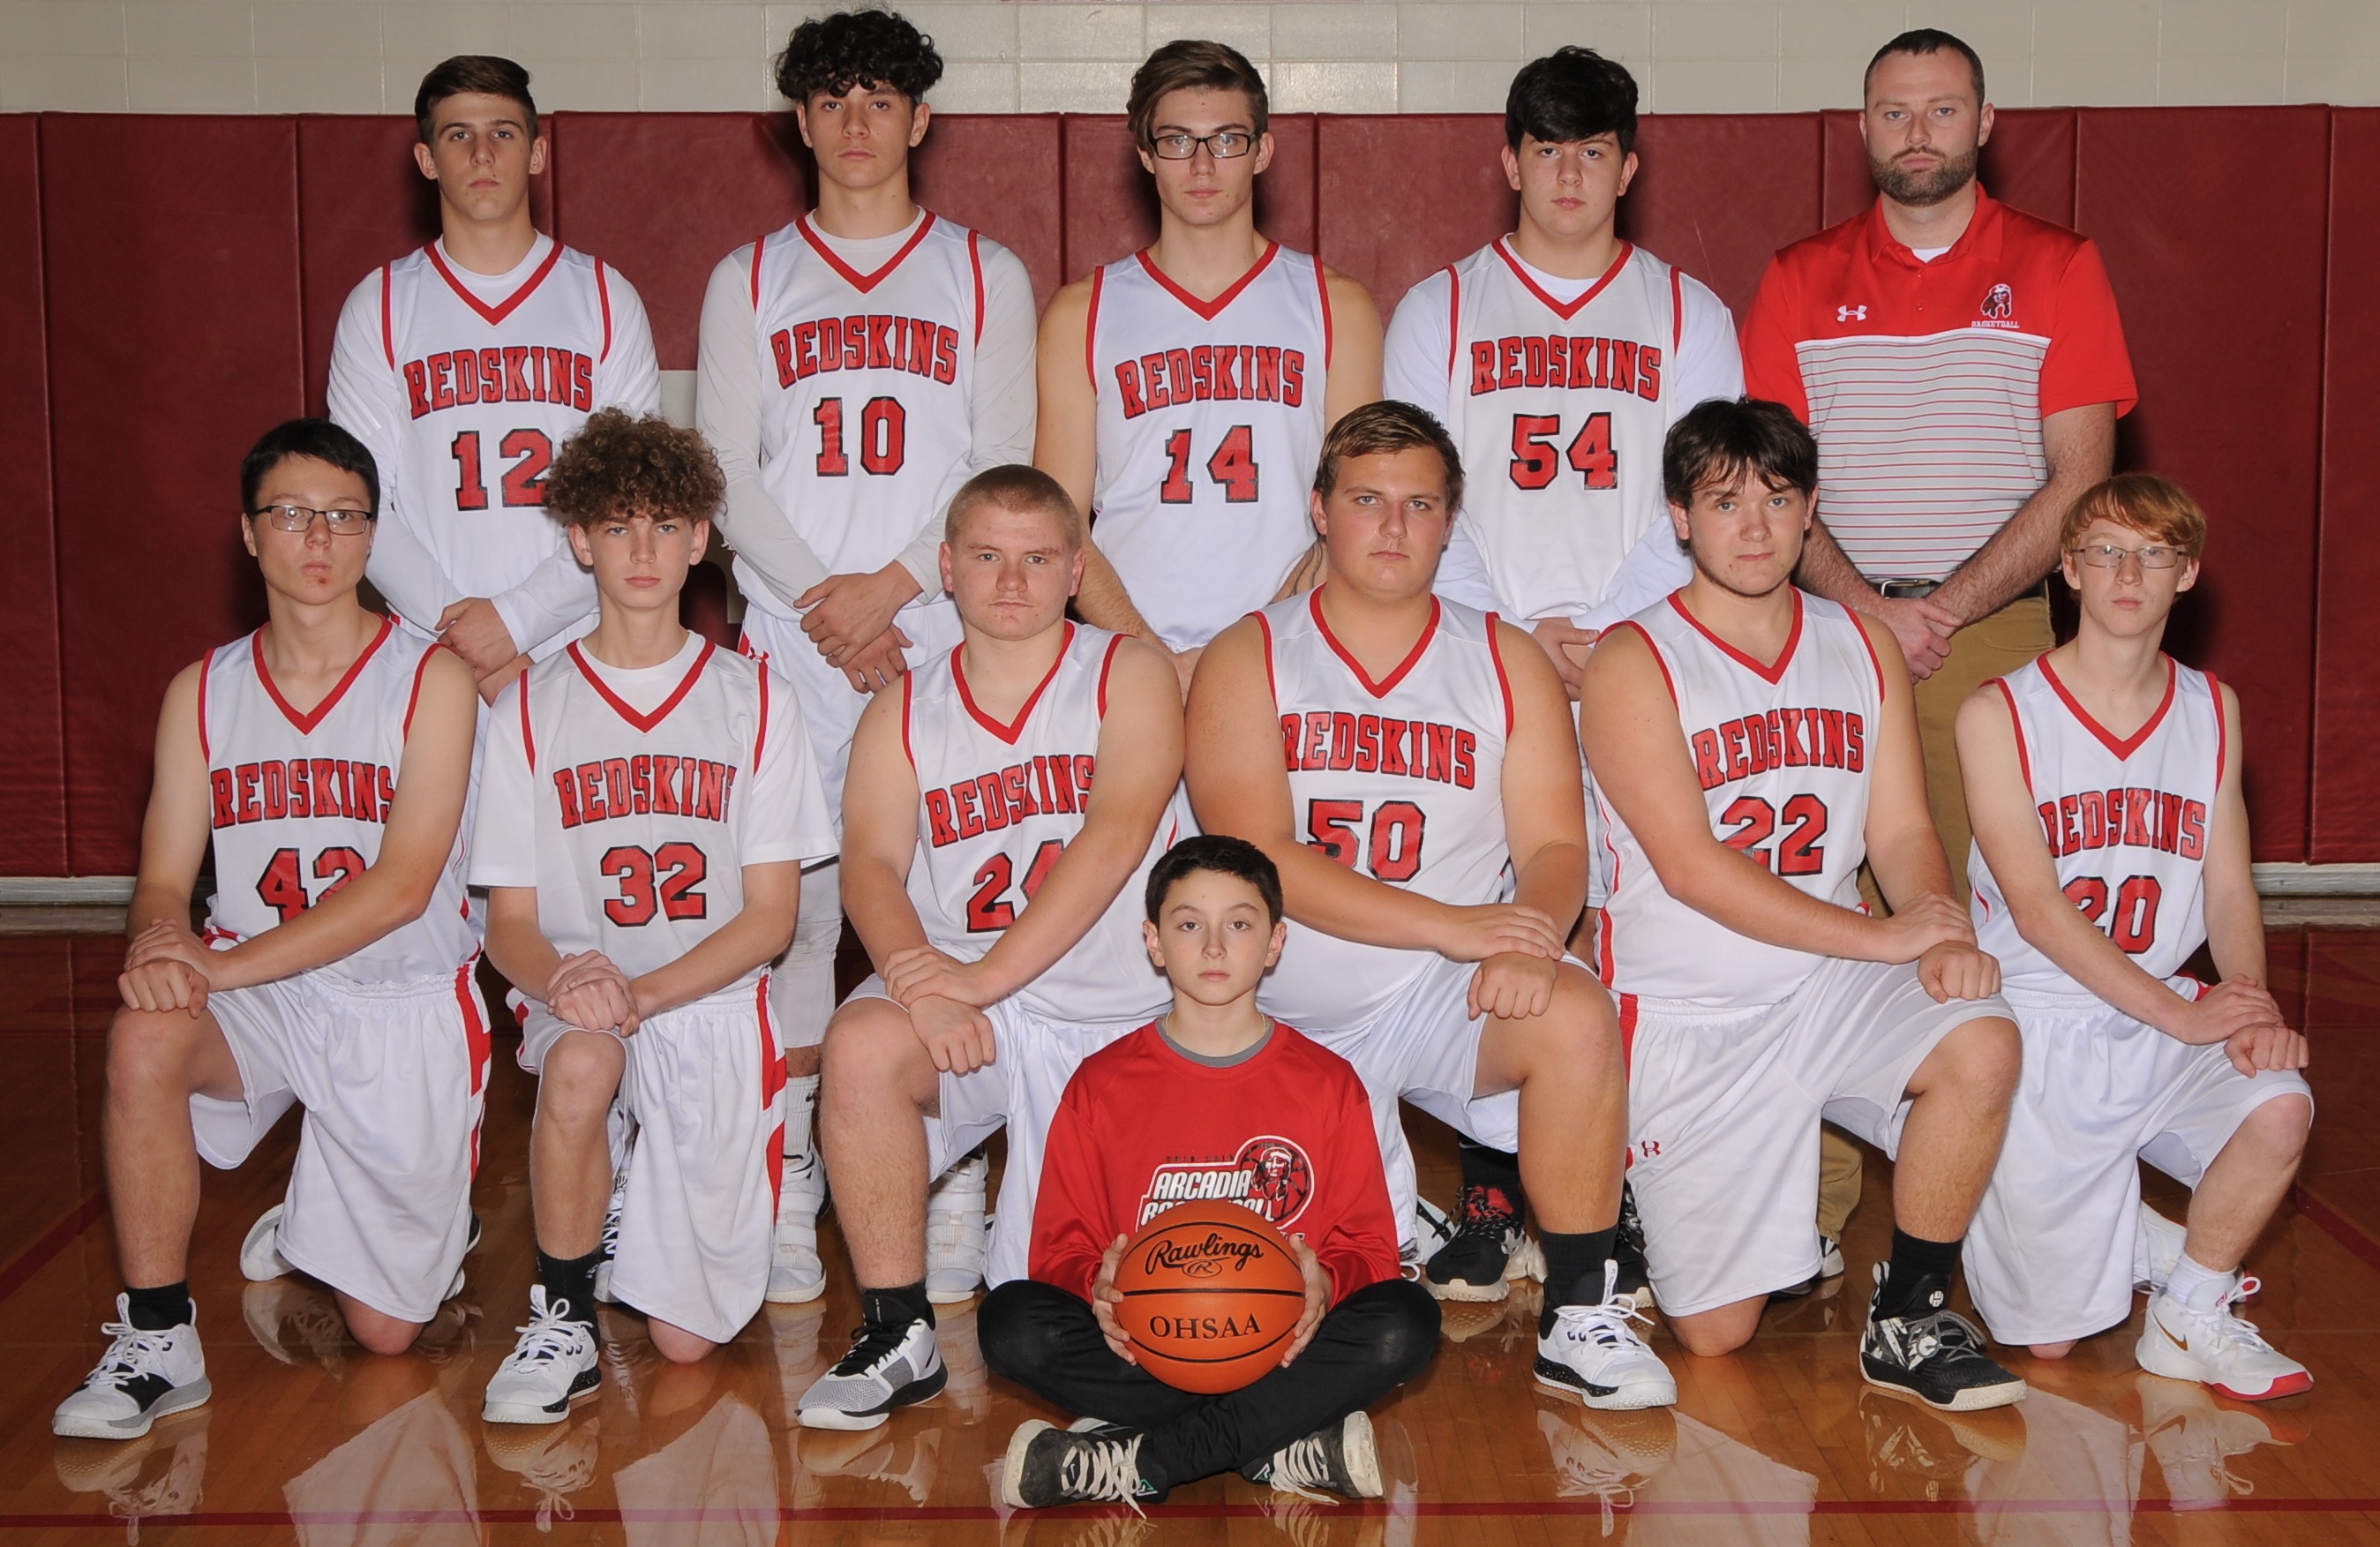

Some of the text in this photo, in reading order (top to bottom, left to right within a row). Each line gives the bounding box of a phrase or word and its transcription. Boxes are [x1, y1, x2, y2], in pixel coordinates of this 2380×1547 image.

[403, 346, 593, 420] REDSKINS
[770, 315, 958, 389] REDSKINS
[1115, 345, 1304, 420] REDSKINS
[1471, 335, 1661, 402] REDSKINS
[451, 428, 552, 512] 12
[814, 396, 906, 477] 10
[1160, 424, 1260, 504] 14
[1509, 412, 1618, 491] 54
[1280, 711, 1477, 791] REDSKINS
[1692, 708, 1865, 791] REDSKINS
[211, 758, 396, 830] REDSKINS
[925, 755, 1094, 849] REDSKINS
[2038, 787, 2206, 862] REDSKINS
[1307, 798, 1426, 882] 50
[1720, 793, 1828, 877] 22
[600, 842, 707, 927] 32
[2061, 875, 2162, 955] 20
[1152, 1169, 1253, 1200] ARCADIA
[1145, 1232, 1265, 1275] Rawlings
[1149, 1313, 1262, 1340] OHSAA
